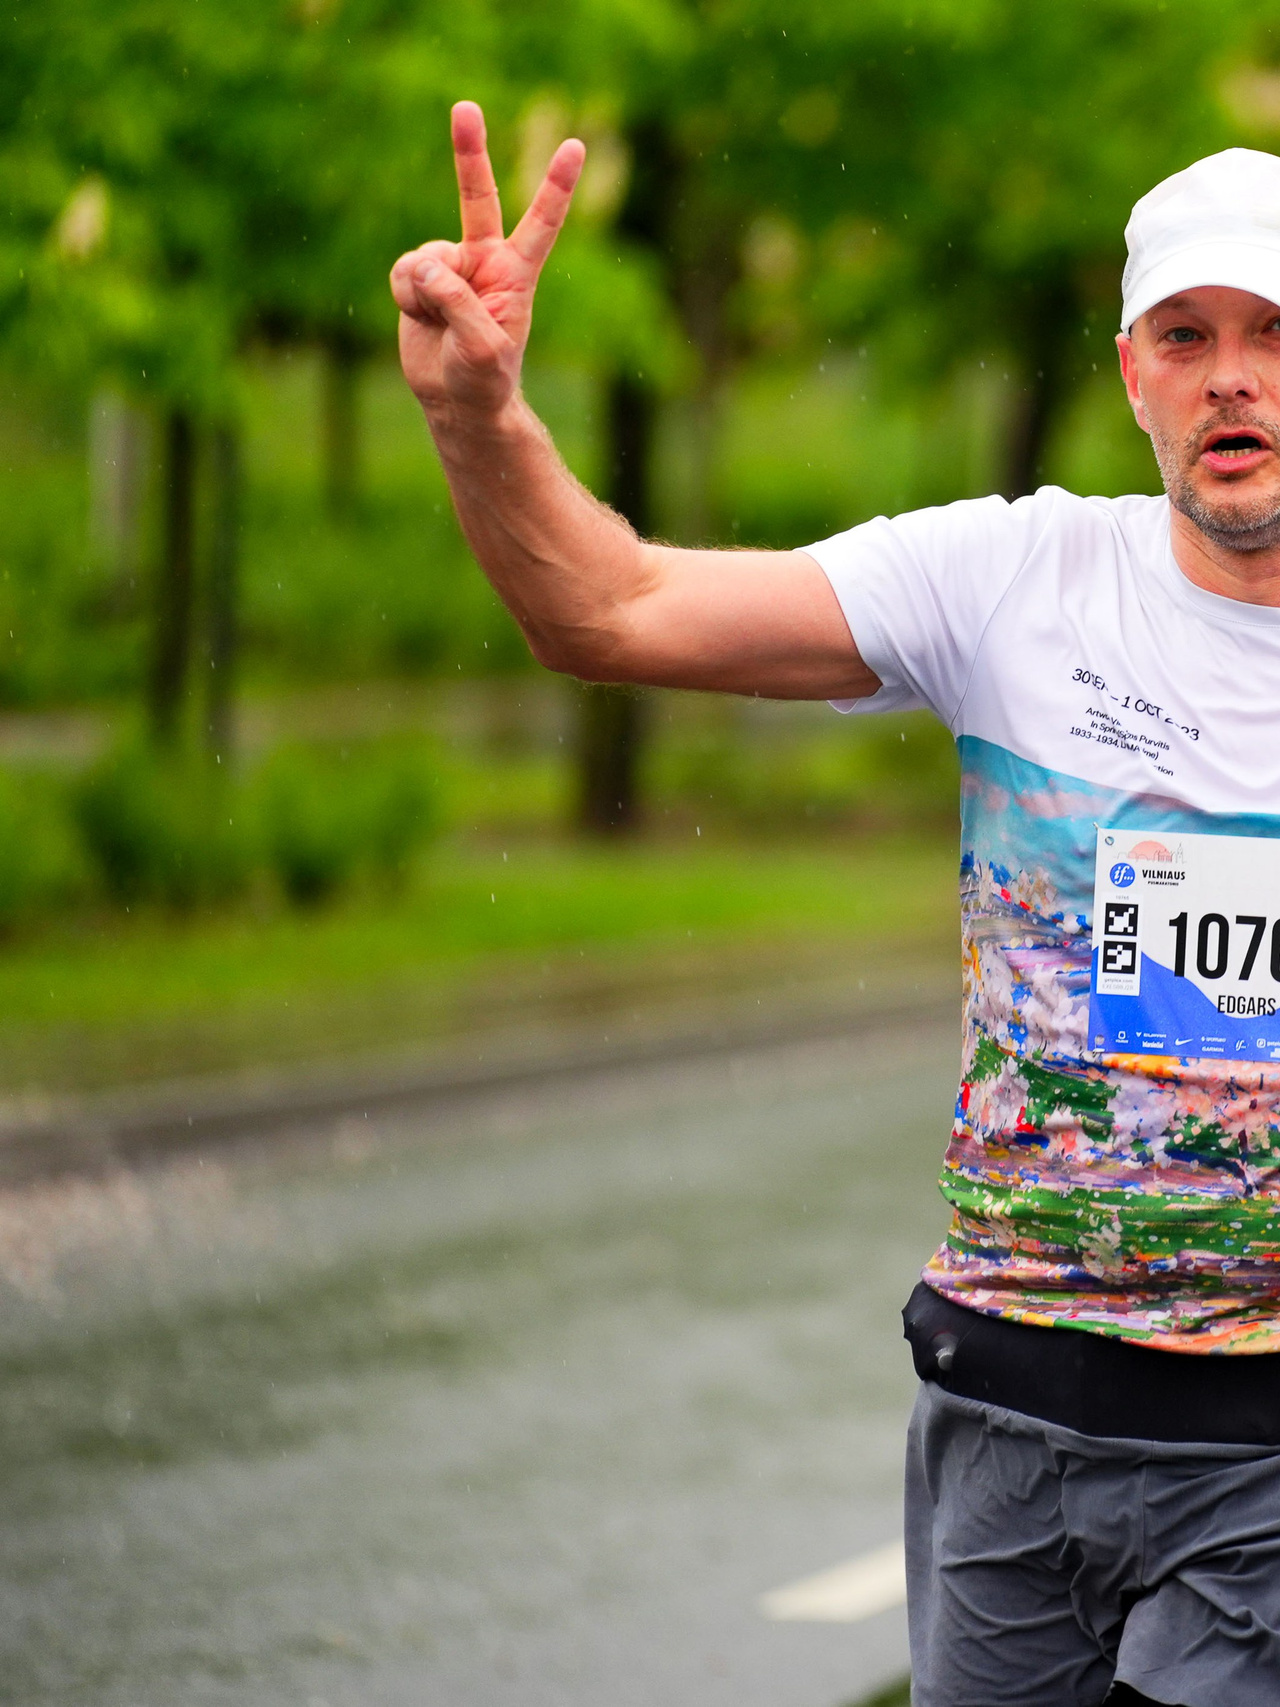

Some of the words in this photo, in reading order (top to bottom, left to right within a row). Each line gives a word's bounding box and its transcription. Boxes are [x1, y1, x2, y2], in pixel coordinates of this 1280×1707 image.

[1072, 668, 1091, 684] 30
[1121, 696, 1131, 708] 1
[1134, 699, 1163, 718] OCT
[1090, 720, 1099, 729] In
[1138, 734, 1170, 751] Purvitis
[1141, 869, 1186, 881] VILNIAUS
[1217, 995, 1276, 1016] EDGARS
